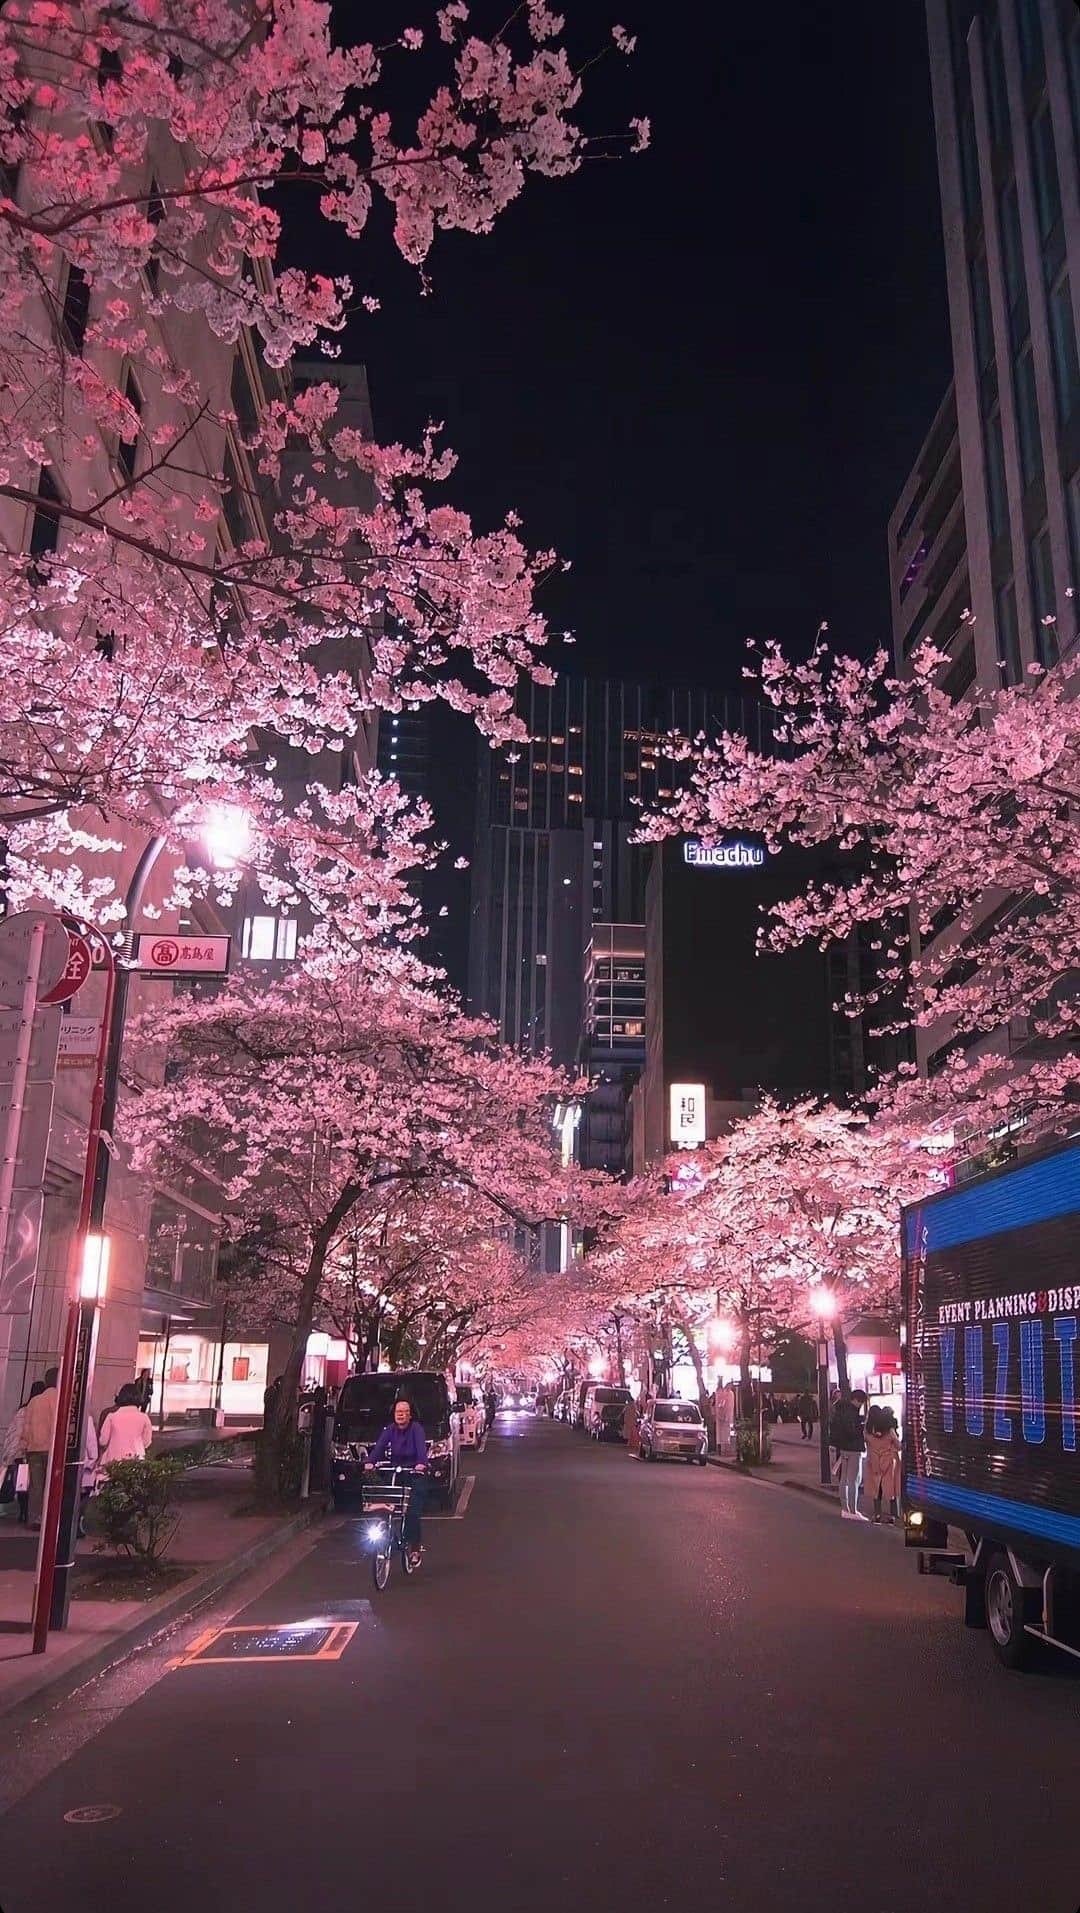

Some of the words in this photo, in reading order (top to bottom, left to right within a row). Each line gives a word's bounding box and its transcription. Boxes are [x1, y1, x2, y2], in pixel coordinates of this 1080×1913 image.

[61, 1025, 96, 1035] リニック
[939, 1302, 971, 1324] EVENT
[975, 1291, 1037, 1321] PLANNING
